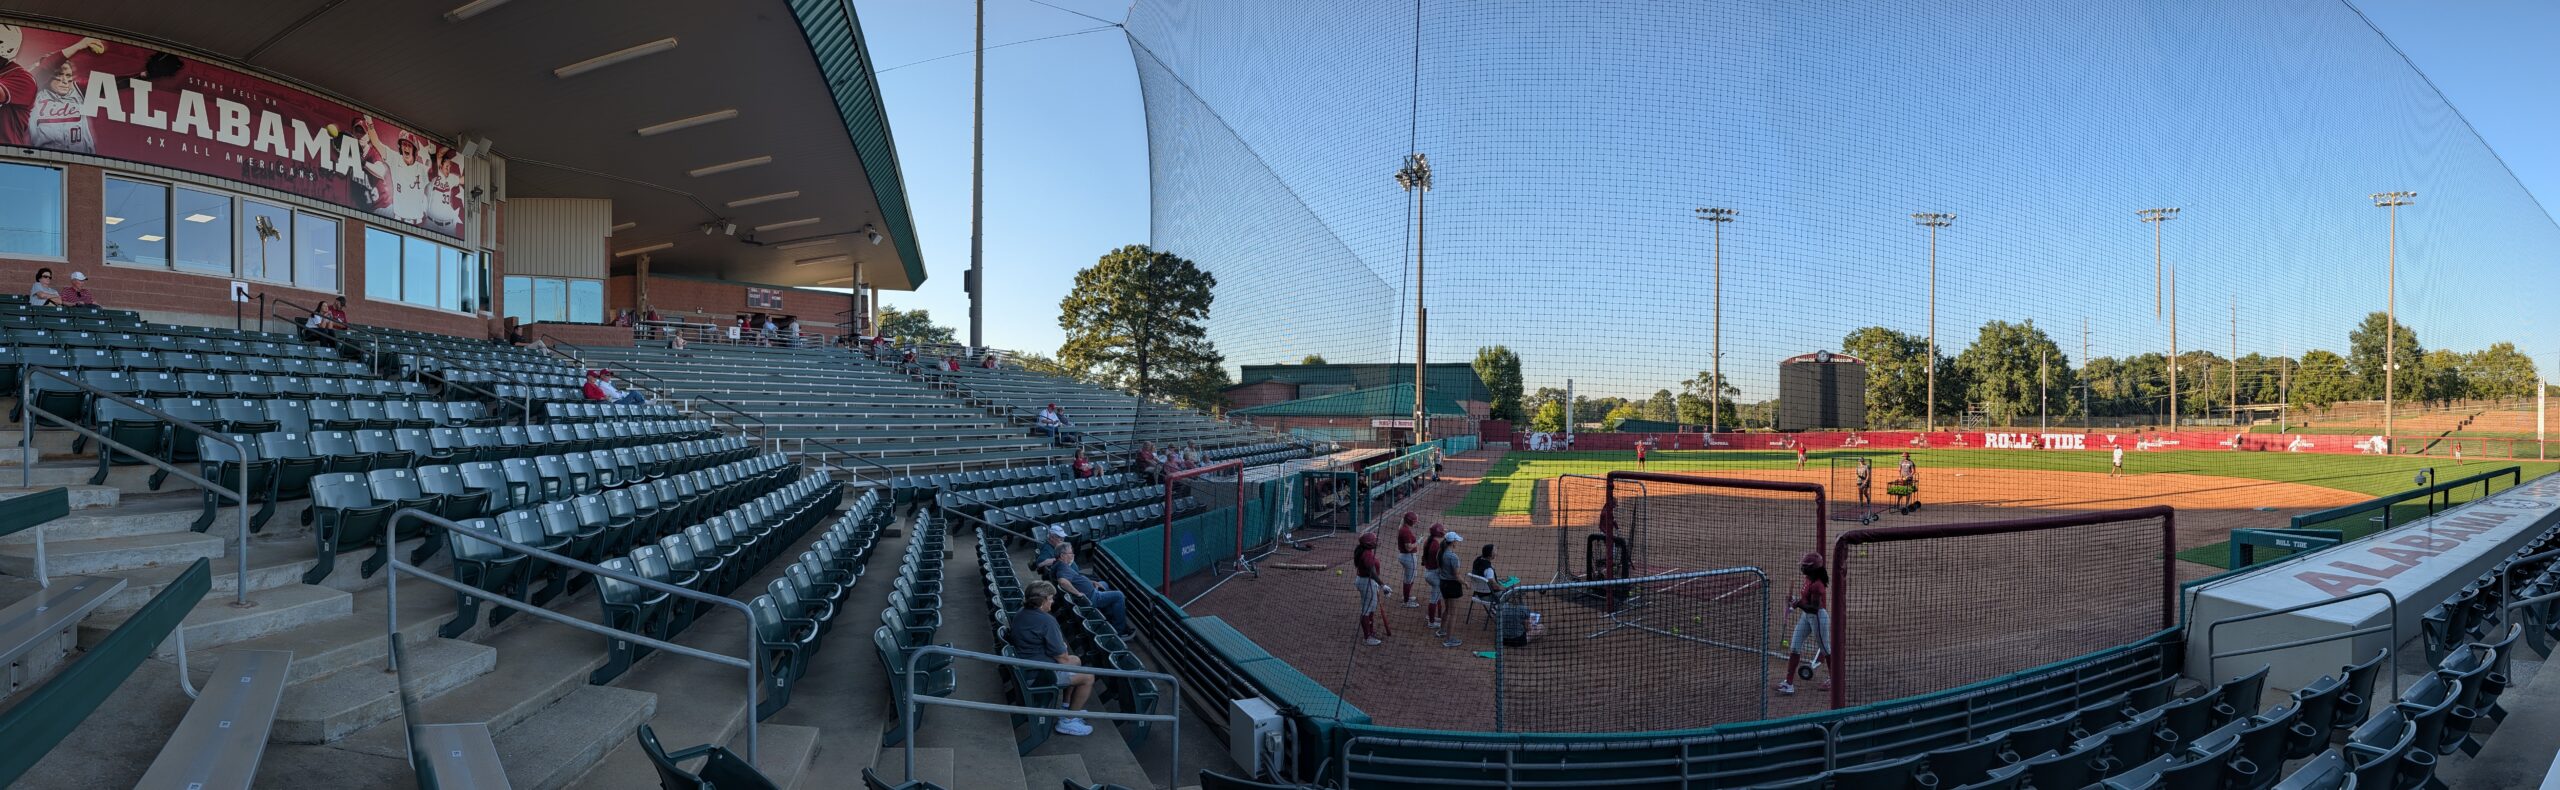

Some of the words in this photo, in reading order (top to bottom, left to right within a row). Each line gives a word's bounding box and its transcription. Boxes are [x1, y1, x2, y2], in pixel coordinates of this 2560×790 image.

[189, 77, 224, 92] STARS
[232, 88, 257, 101] FELL
[265, 98, 278, 106] ON
[39, 100, 80, 117] Tide
[80, 70, 368, 185] ALABAMA
[146, 136, 166, 148] 4X
[182, 143, 210, 157] ALL
[225, 152, 315, 182] AMERICANS
[1985, 432, 2032, 449] ROLL
[2041, 433, 2086, 450] TIDE
[2293, 540, 2308, 549] TIDE
[2293, 510, 2519, 598] ALABAMA
